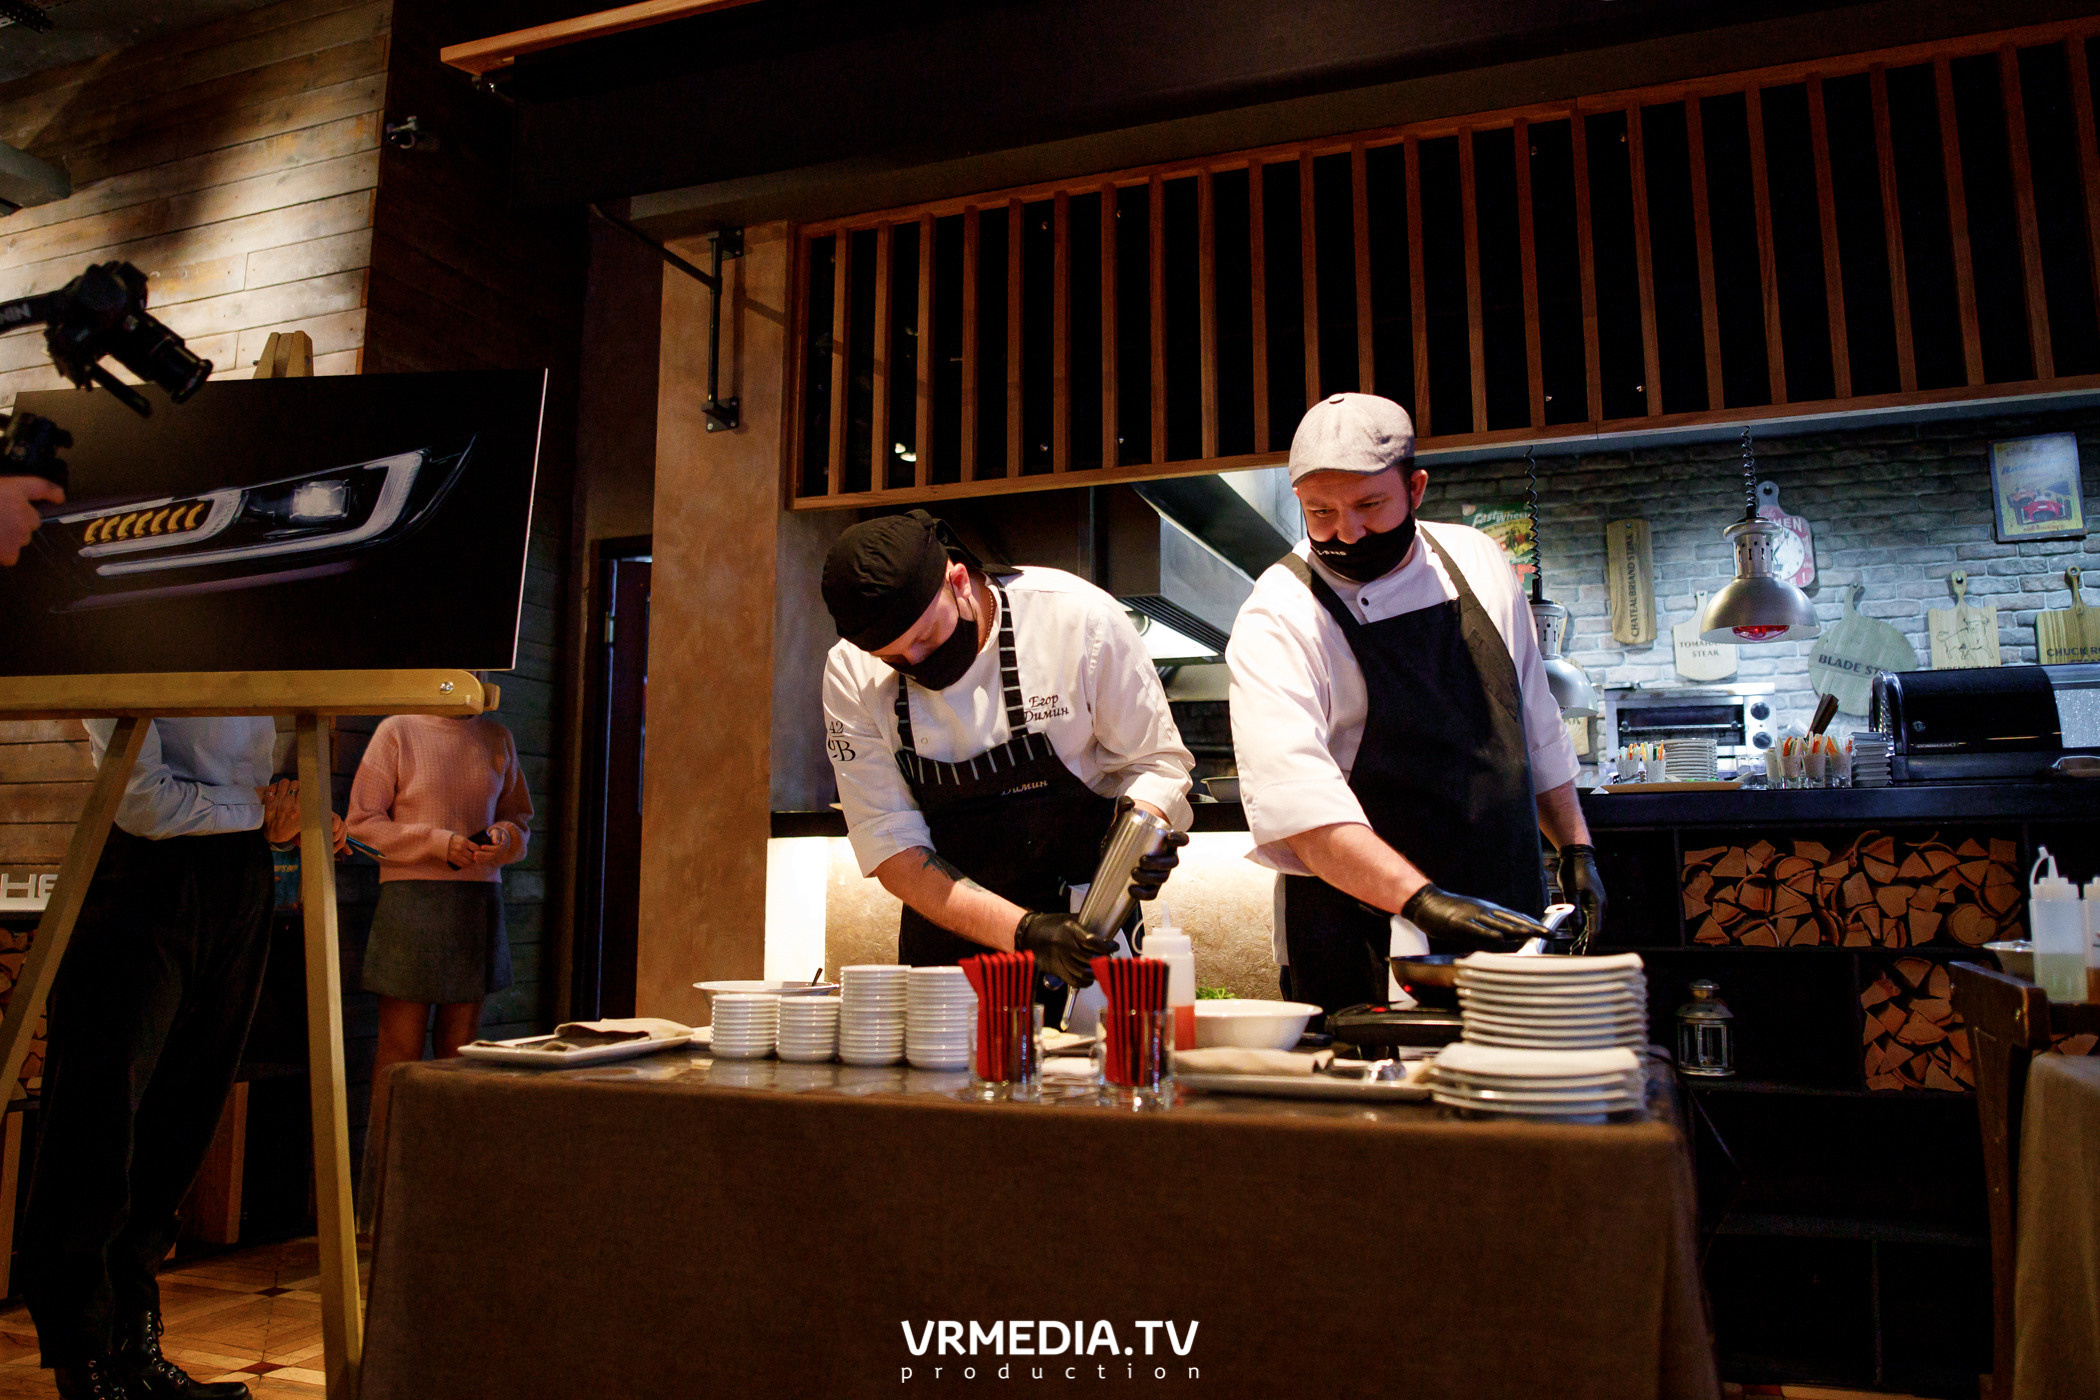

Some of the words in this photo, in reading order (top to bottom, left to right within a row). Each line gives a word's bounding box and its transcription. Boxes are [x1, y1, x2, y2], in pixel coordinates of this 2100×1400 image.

[1692, 650, 1720, 658] STEAK
[2046, 646, 2088, 657] CHUCK
[1818, 654, 1861, 673] BLADE
[1028, 694, 1059, 708] Егор
[1024, 707, 1069, 722] Димин
[829, 720, 844, 734] 42
